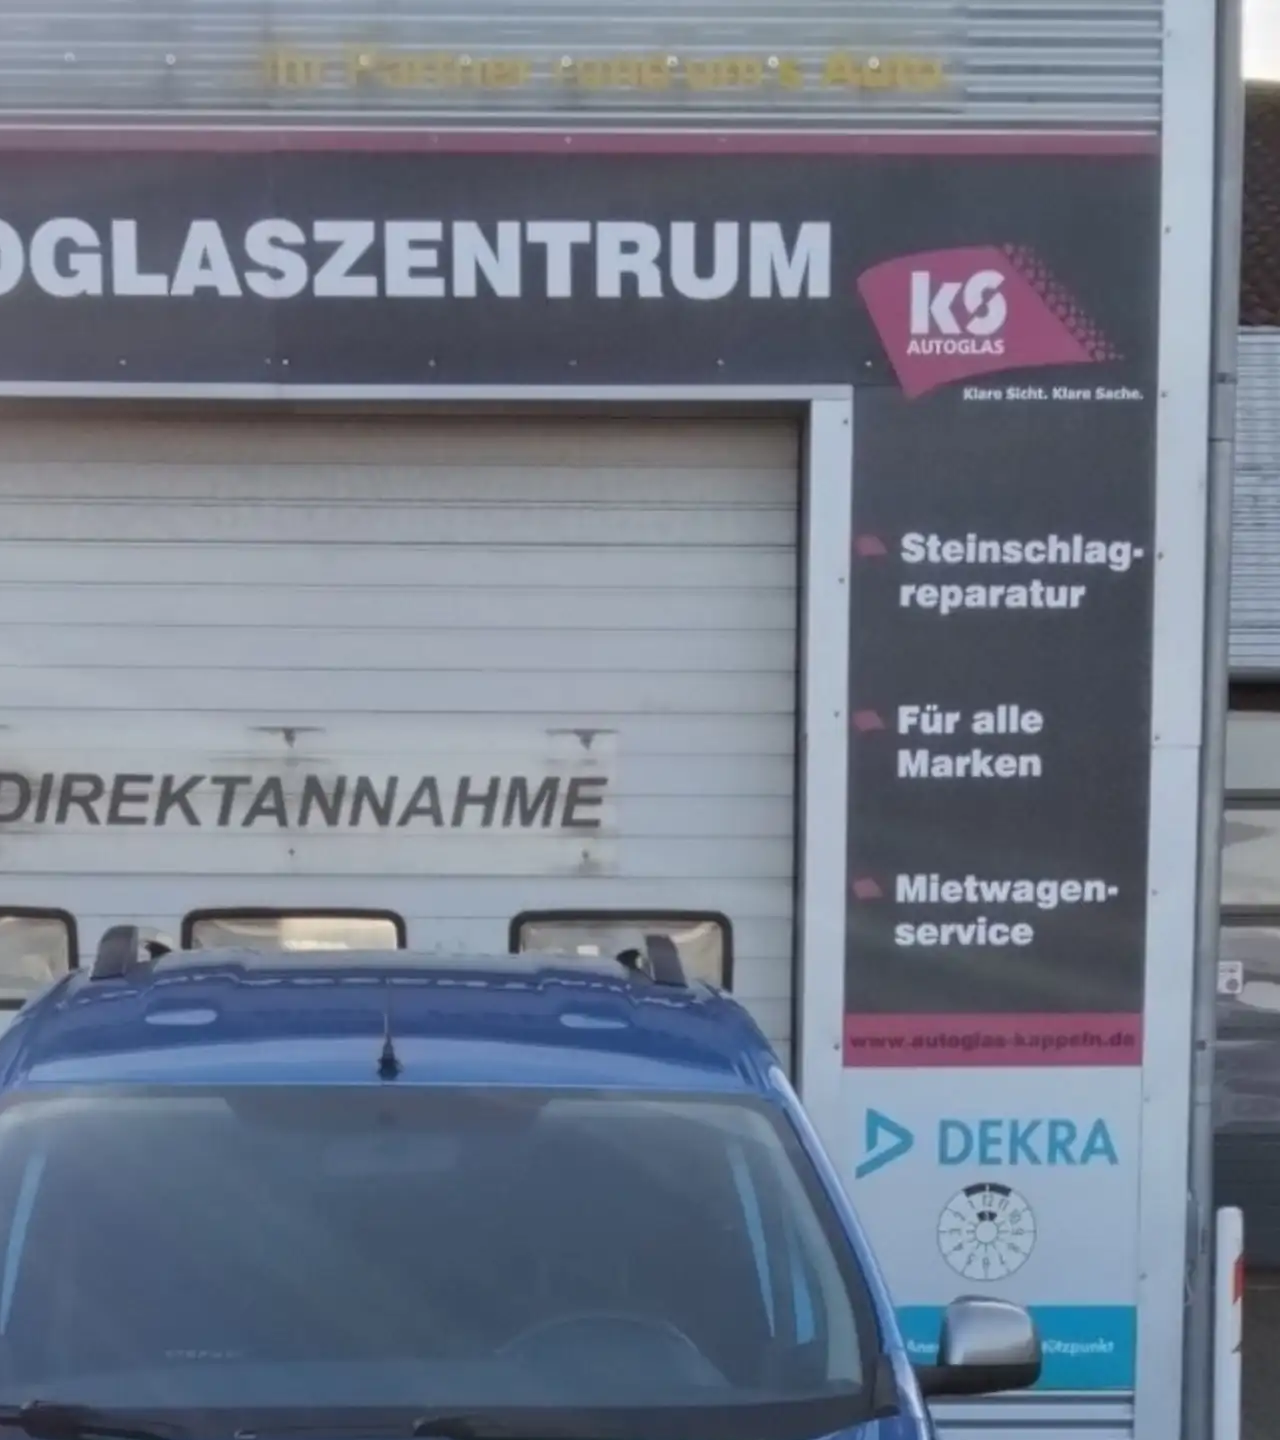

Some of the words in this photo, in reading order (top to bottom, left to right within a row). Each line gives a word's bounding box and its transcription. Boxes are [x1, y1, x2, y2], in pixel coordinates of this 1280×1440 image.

[907, 338, 1005, 355] AUTOGLAS
[963, 387, 1003, 400] Klare
[1006, 387, 1048, 400] Sicht.
[1052, 387, 1092, 400] Klare
[1095, 387, 1144, 400] Sache.
[900, 532, 1144, 572] Steinschlag-
[899, 579, 1086, 616] reparatur
[897, 704, 961, 735] Für
[972, 704, 1044, 735] alle
[897, 748, 1042, 778] Marken
[895, 873, 1119, 910] Mietwagen-
[894, 916, 1034, 946] service
[937, 1117, 1119, 1166] DEKRA
